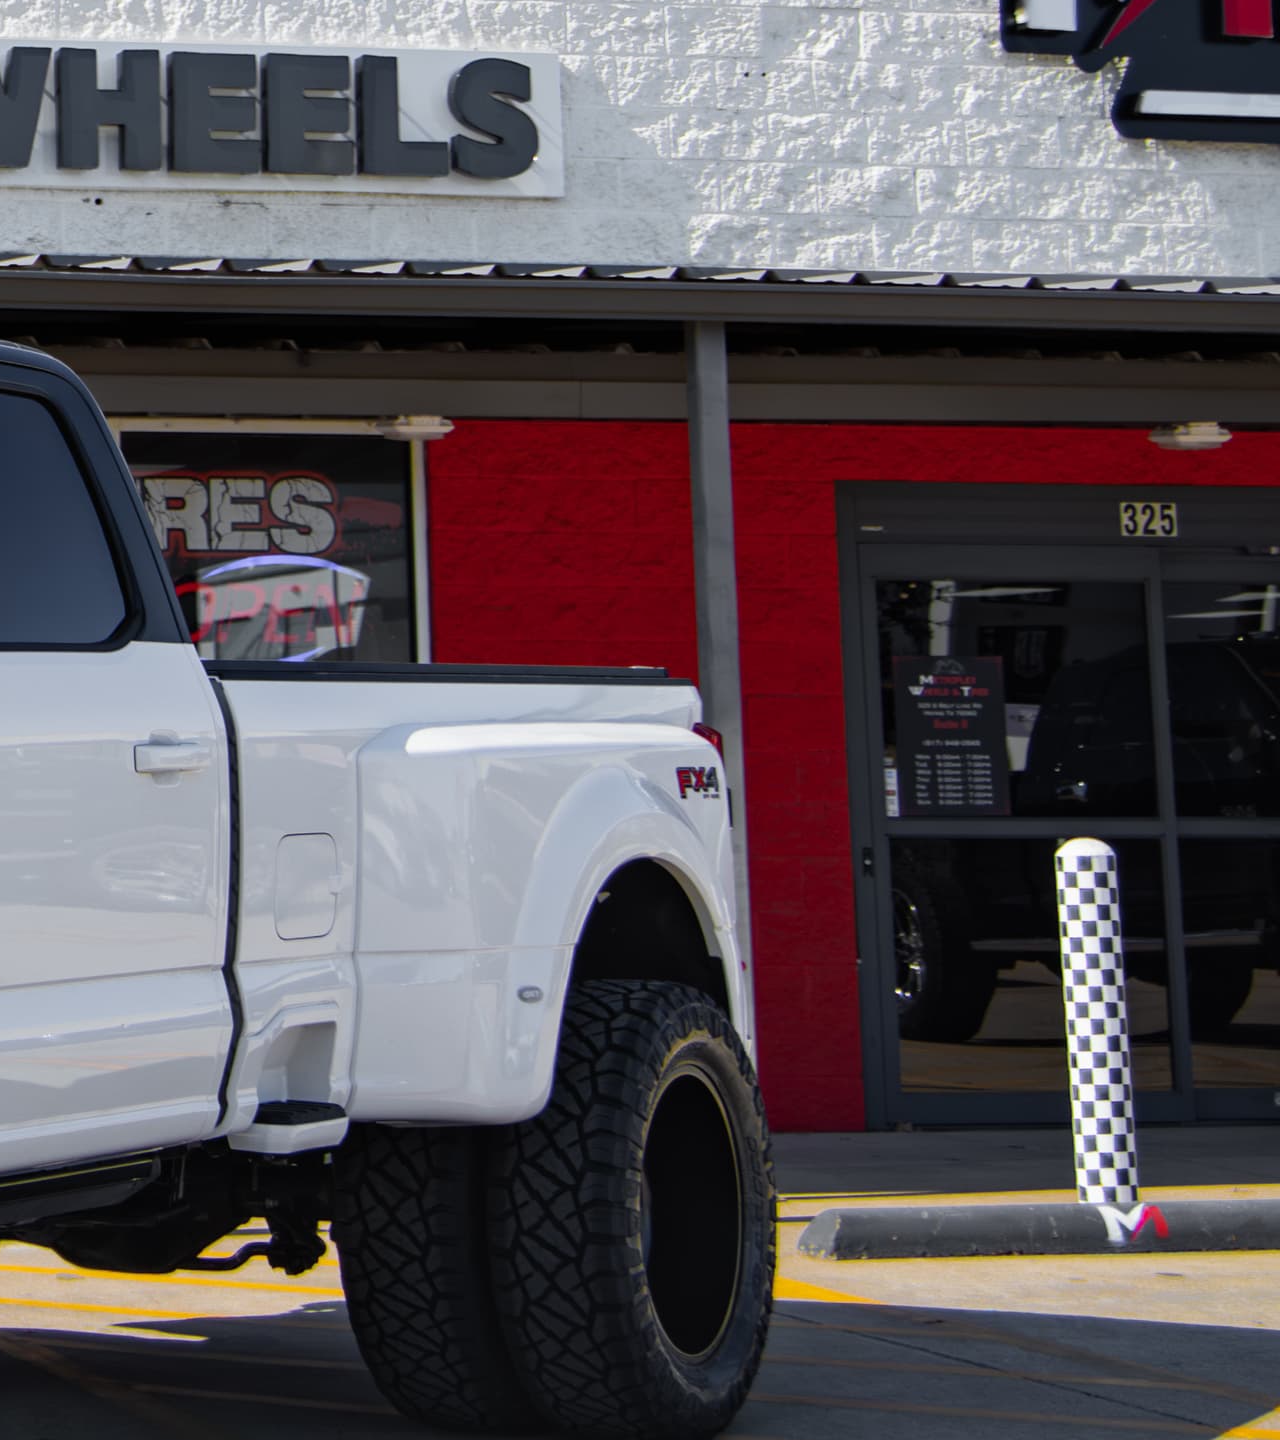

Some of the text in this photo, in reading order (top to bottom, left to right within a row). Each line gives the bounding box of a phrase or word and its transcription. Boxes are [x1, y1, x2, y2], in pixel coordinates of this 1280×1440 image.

[135, 477, 337, 554] RES
[1124, 504, 1173, 535] 325
[174, 581, 364, 643] OPEN
[676, 766, 719, 799] FX4
